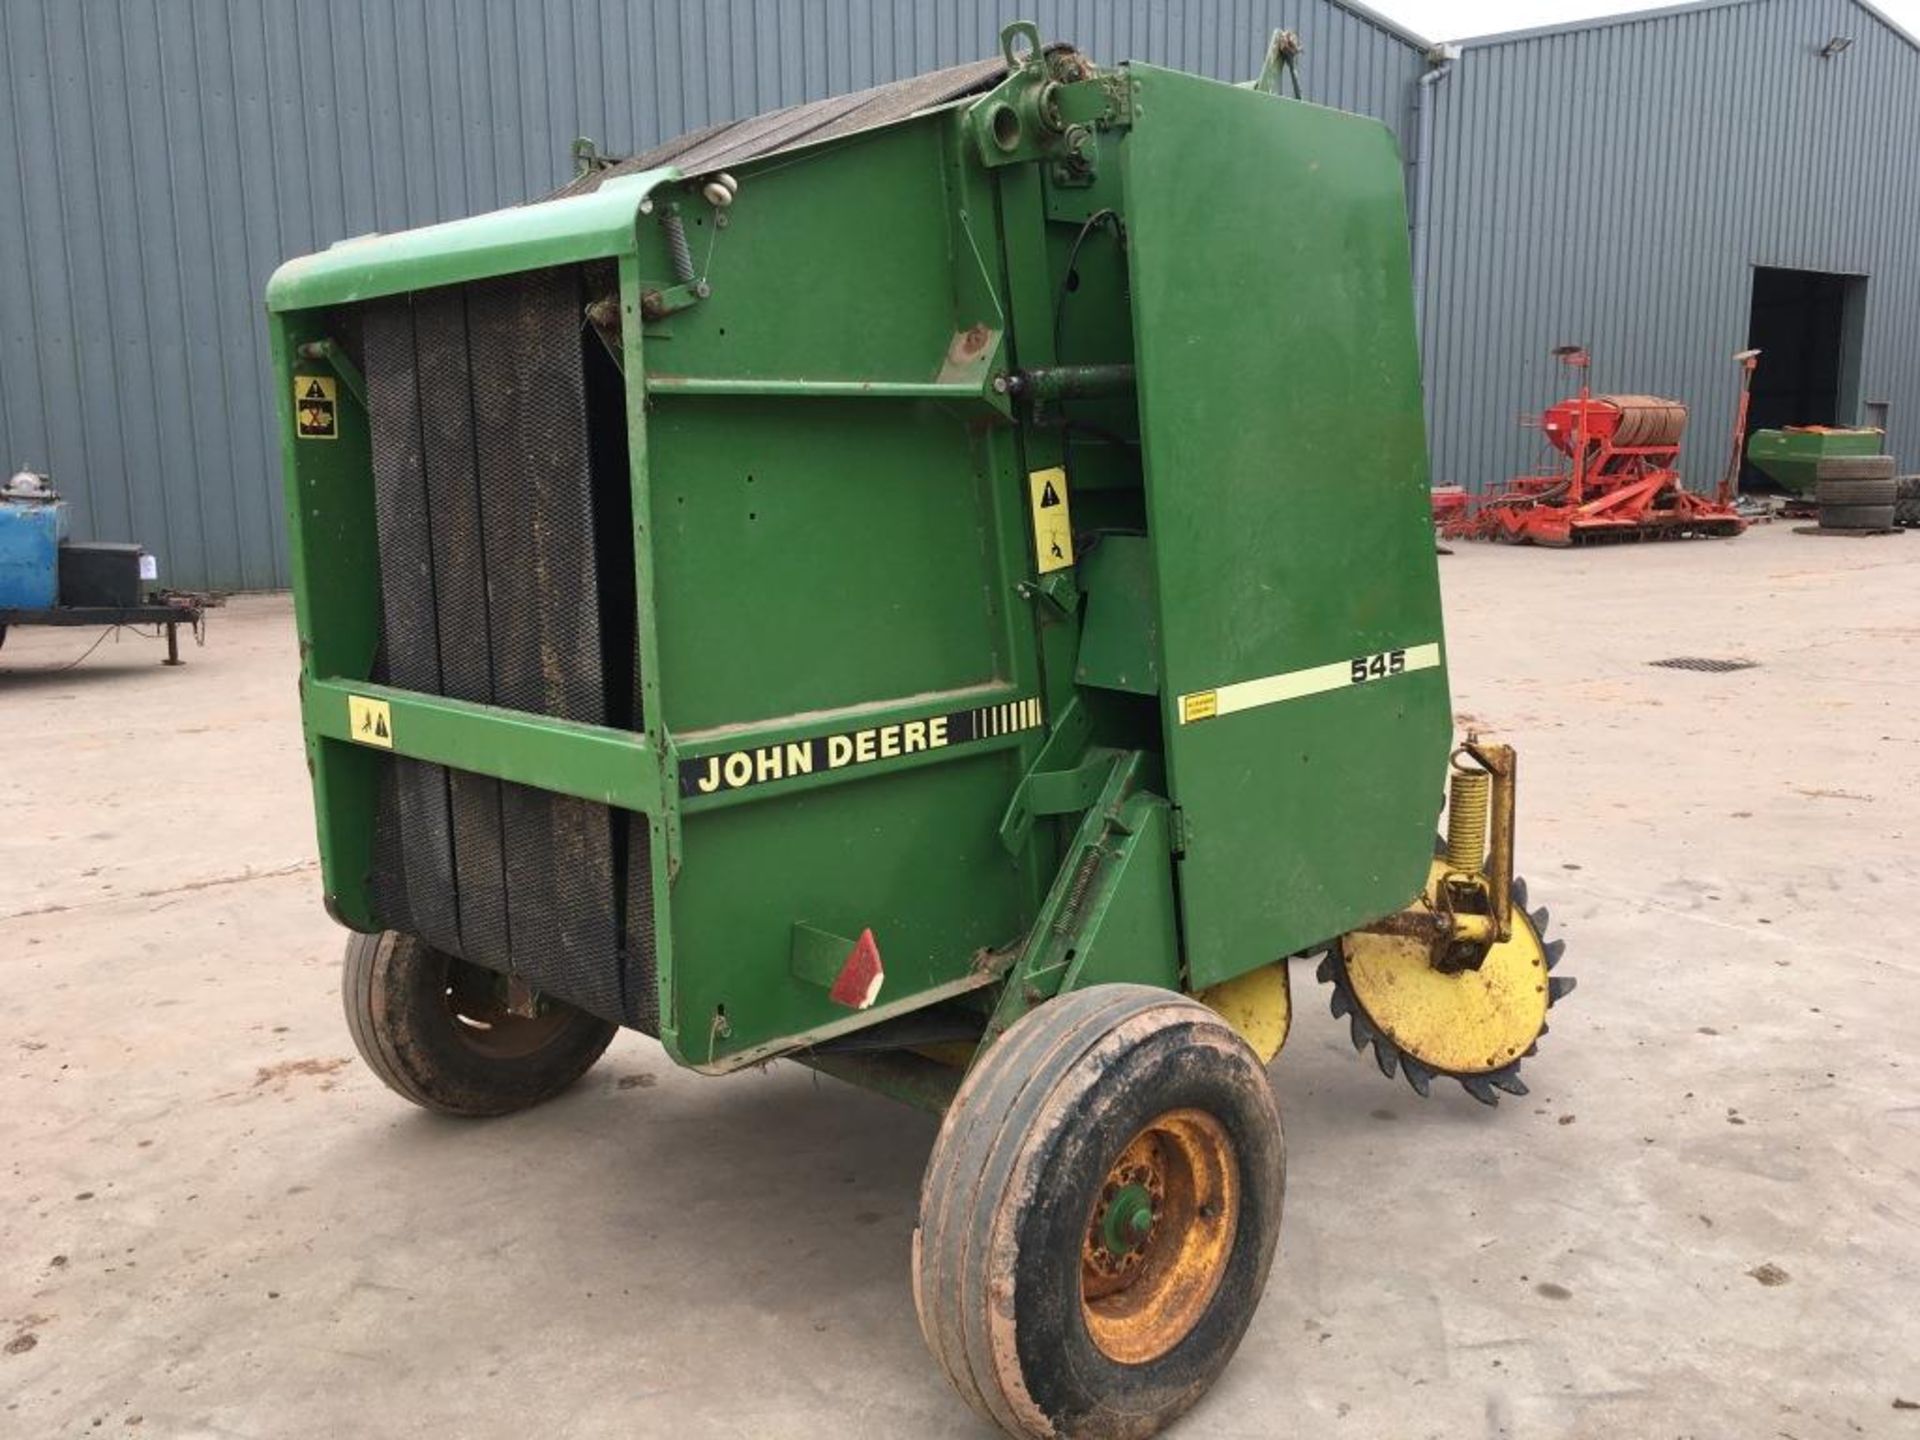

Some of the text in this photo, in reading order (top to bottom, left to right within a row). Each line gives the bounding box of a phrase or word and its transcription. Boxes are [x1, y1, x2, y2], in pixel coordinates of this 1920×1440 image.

[1351, 650, 1405, 684] 545
[698, 716, 949, 793] JOHN DEERE
